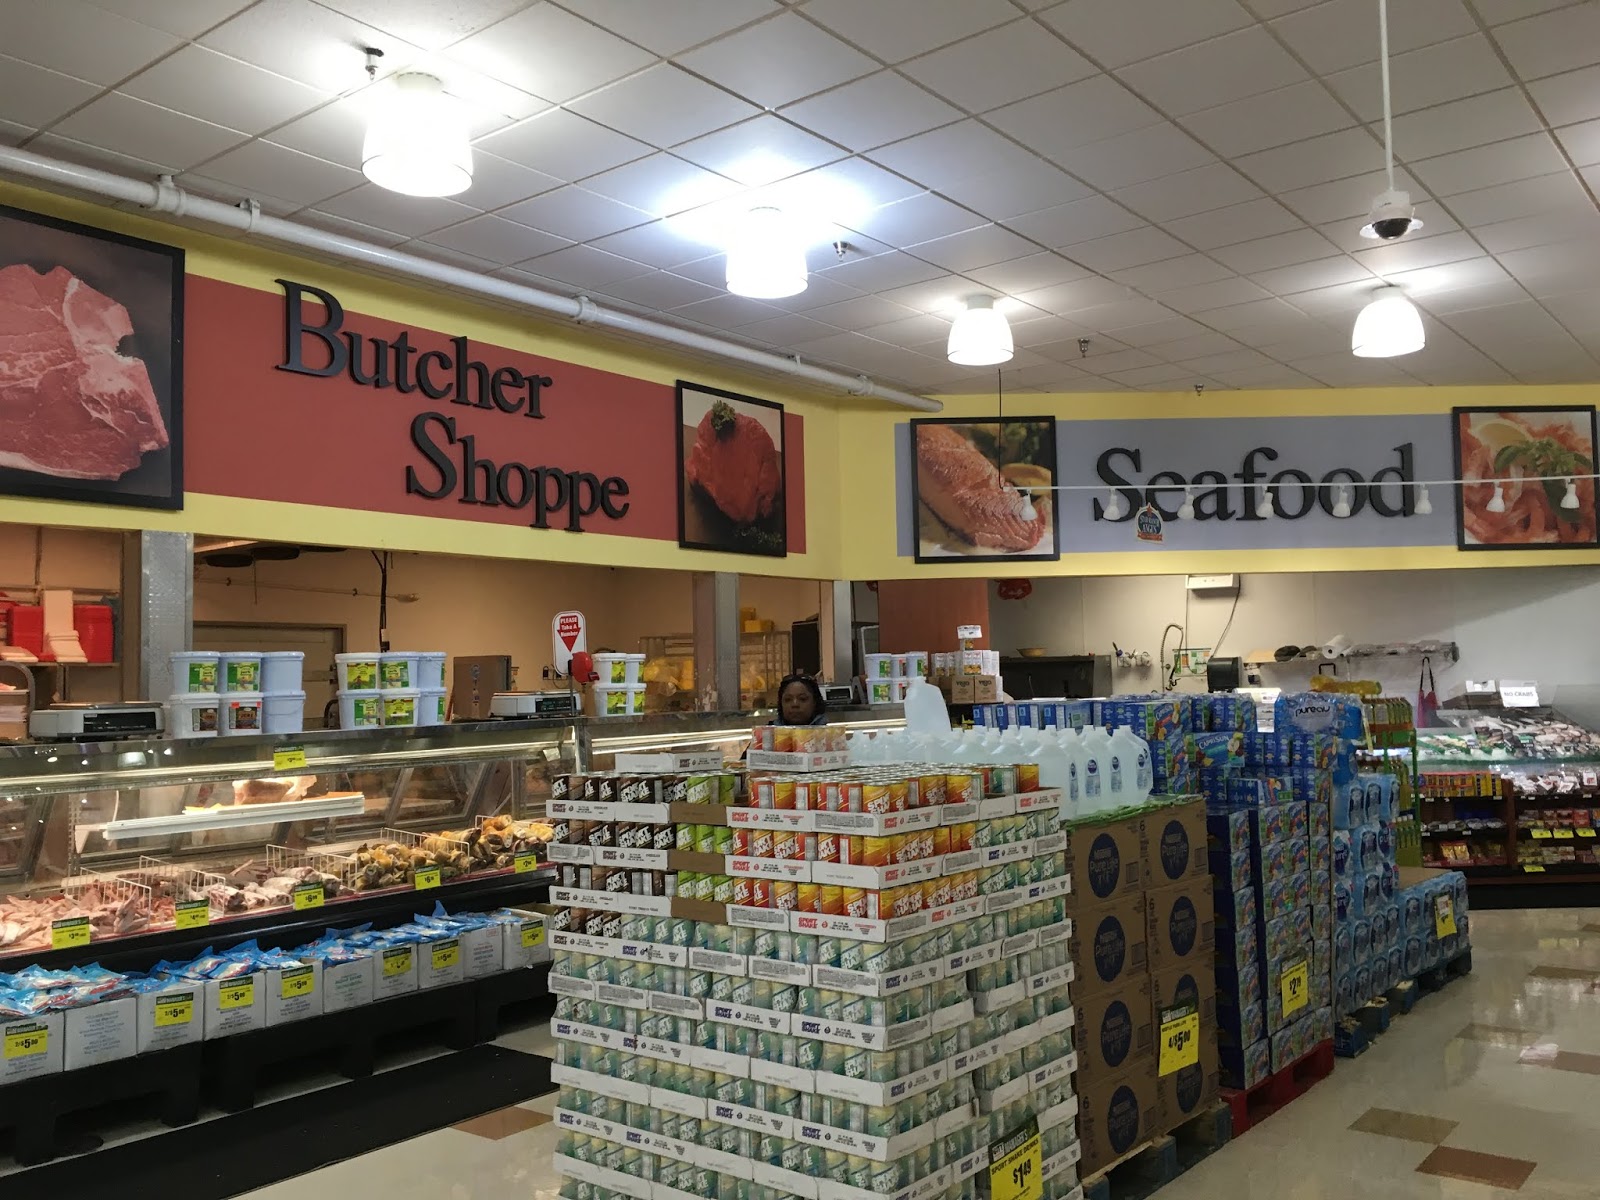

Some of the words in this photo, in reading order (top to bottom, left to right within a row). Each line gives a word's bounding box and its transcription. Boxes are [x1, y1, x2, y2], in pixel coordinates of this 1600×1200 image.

[276, 278, 552, 419] Butcher
[406, 410, 629, 531] Shoppe
[1094, 443, 1414, 522] Seafood
[991, 1162, 1007, 1175] SPORT
[1008, 1154, 1023, 1164] SHAKE
[1024, 1138, 1039, 1153] DRINKS
